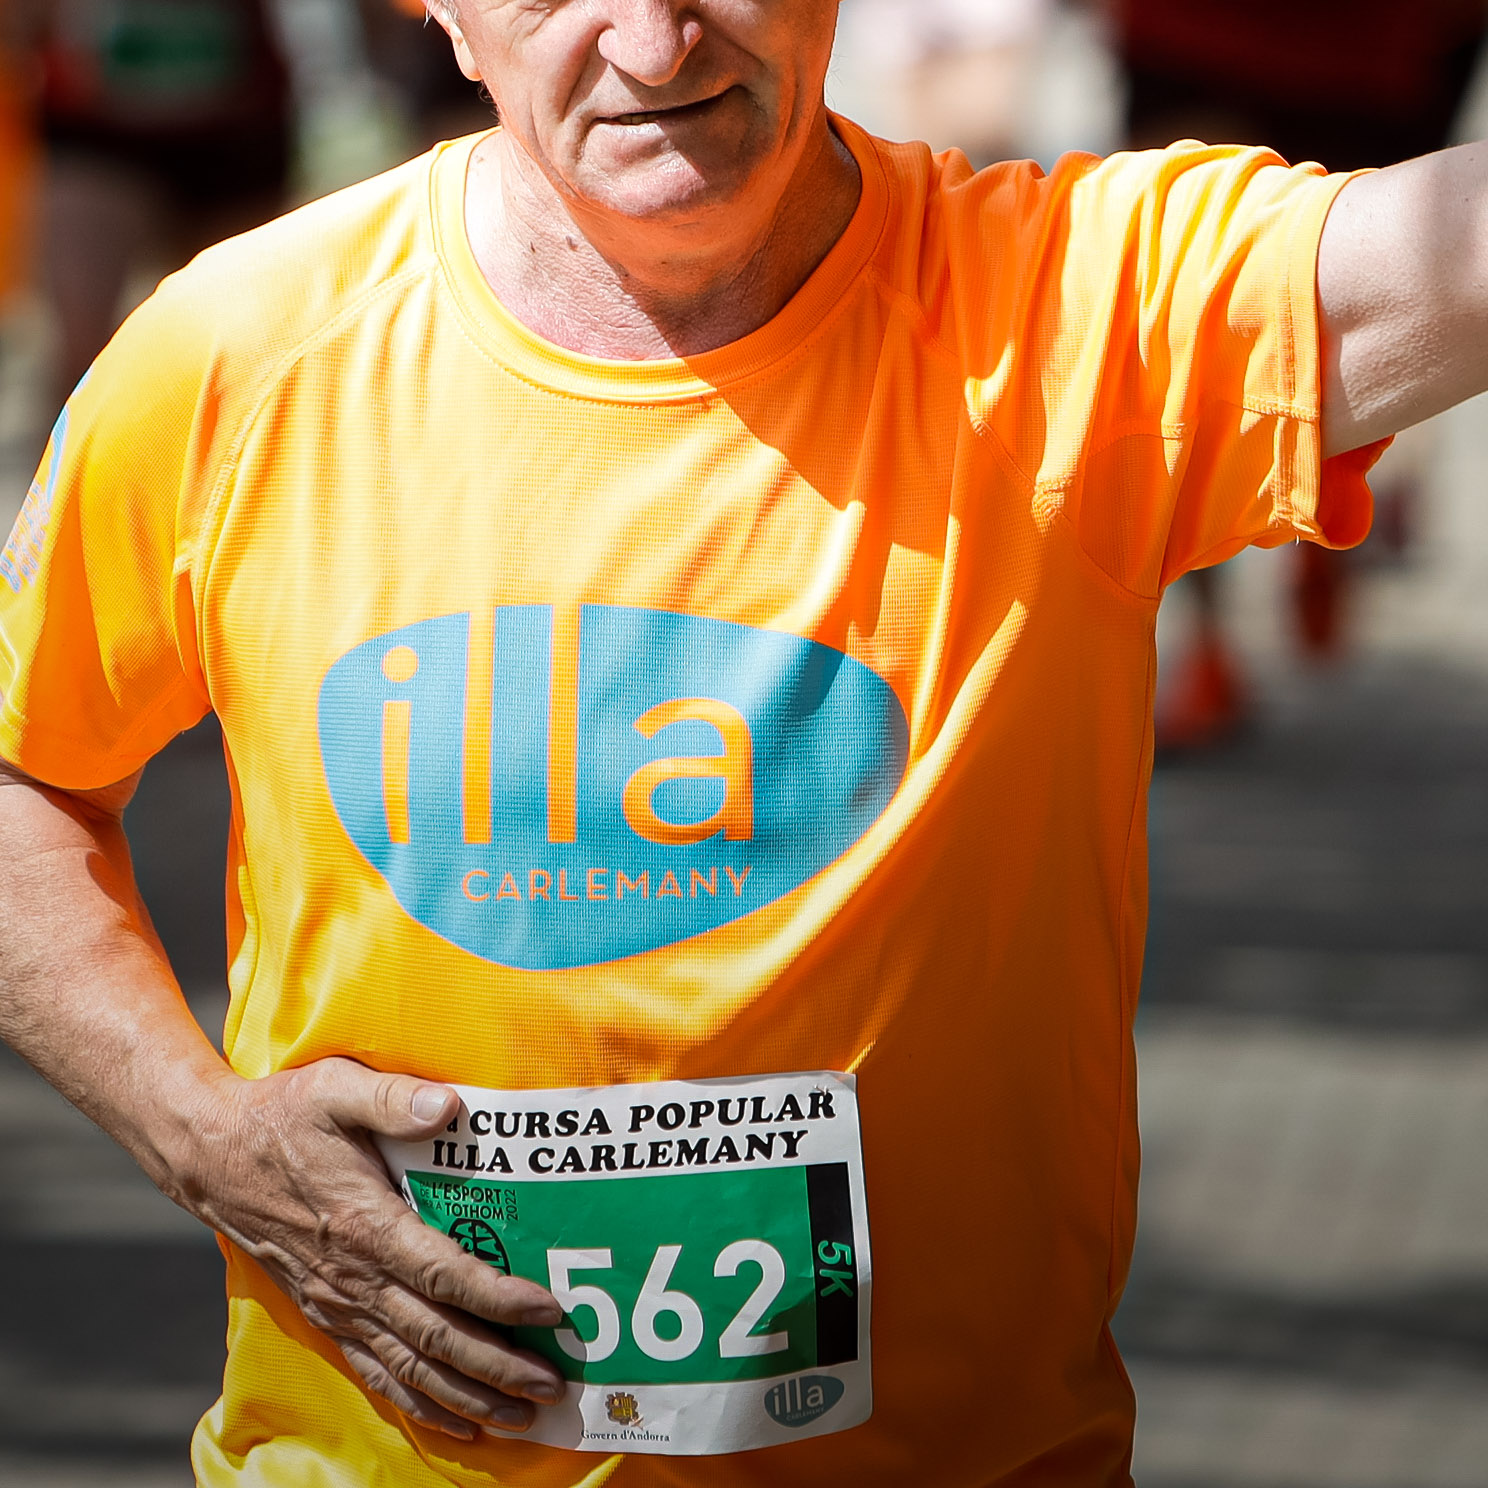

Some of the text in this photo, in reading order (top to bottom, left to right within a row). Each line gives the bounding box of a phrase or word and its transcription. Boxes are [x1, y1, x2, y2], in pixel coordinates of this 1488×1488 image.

[381, 604, 753, 845] illa
[461, 865, 753, 903] CARLEMANY
[469, 1108, 613, 1139] CURSA
[627, 1091, 837, 1134] POPULAR
[432, 1129, 809, 1174] ILLA CARLEMANY
[420, 1188, 430, 1199] DE
[432, 1181, 502, 1205] L'ESPORT
[445, 1202, 505, 1221] TOTHOM
[504, 1188, 519, 1222] 2022
[817, 1239, 854, 1300] 5K
[545, 1239, 790, 1363] 562
[773, 1377, 824, 1416] illa
[581, 1429, 670, 1443] Govern d'Andorra
